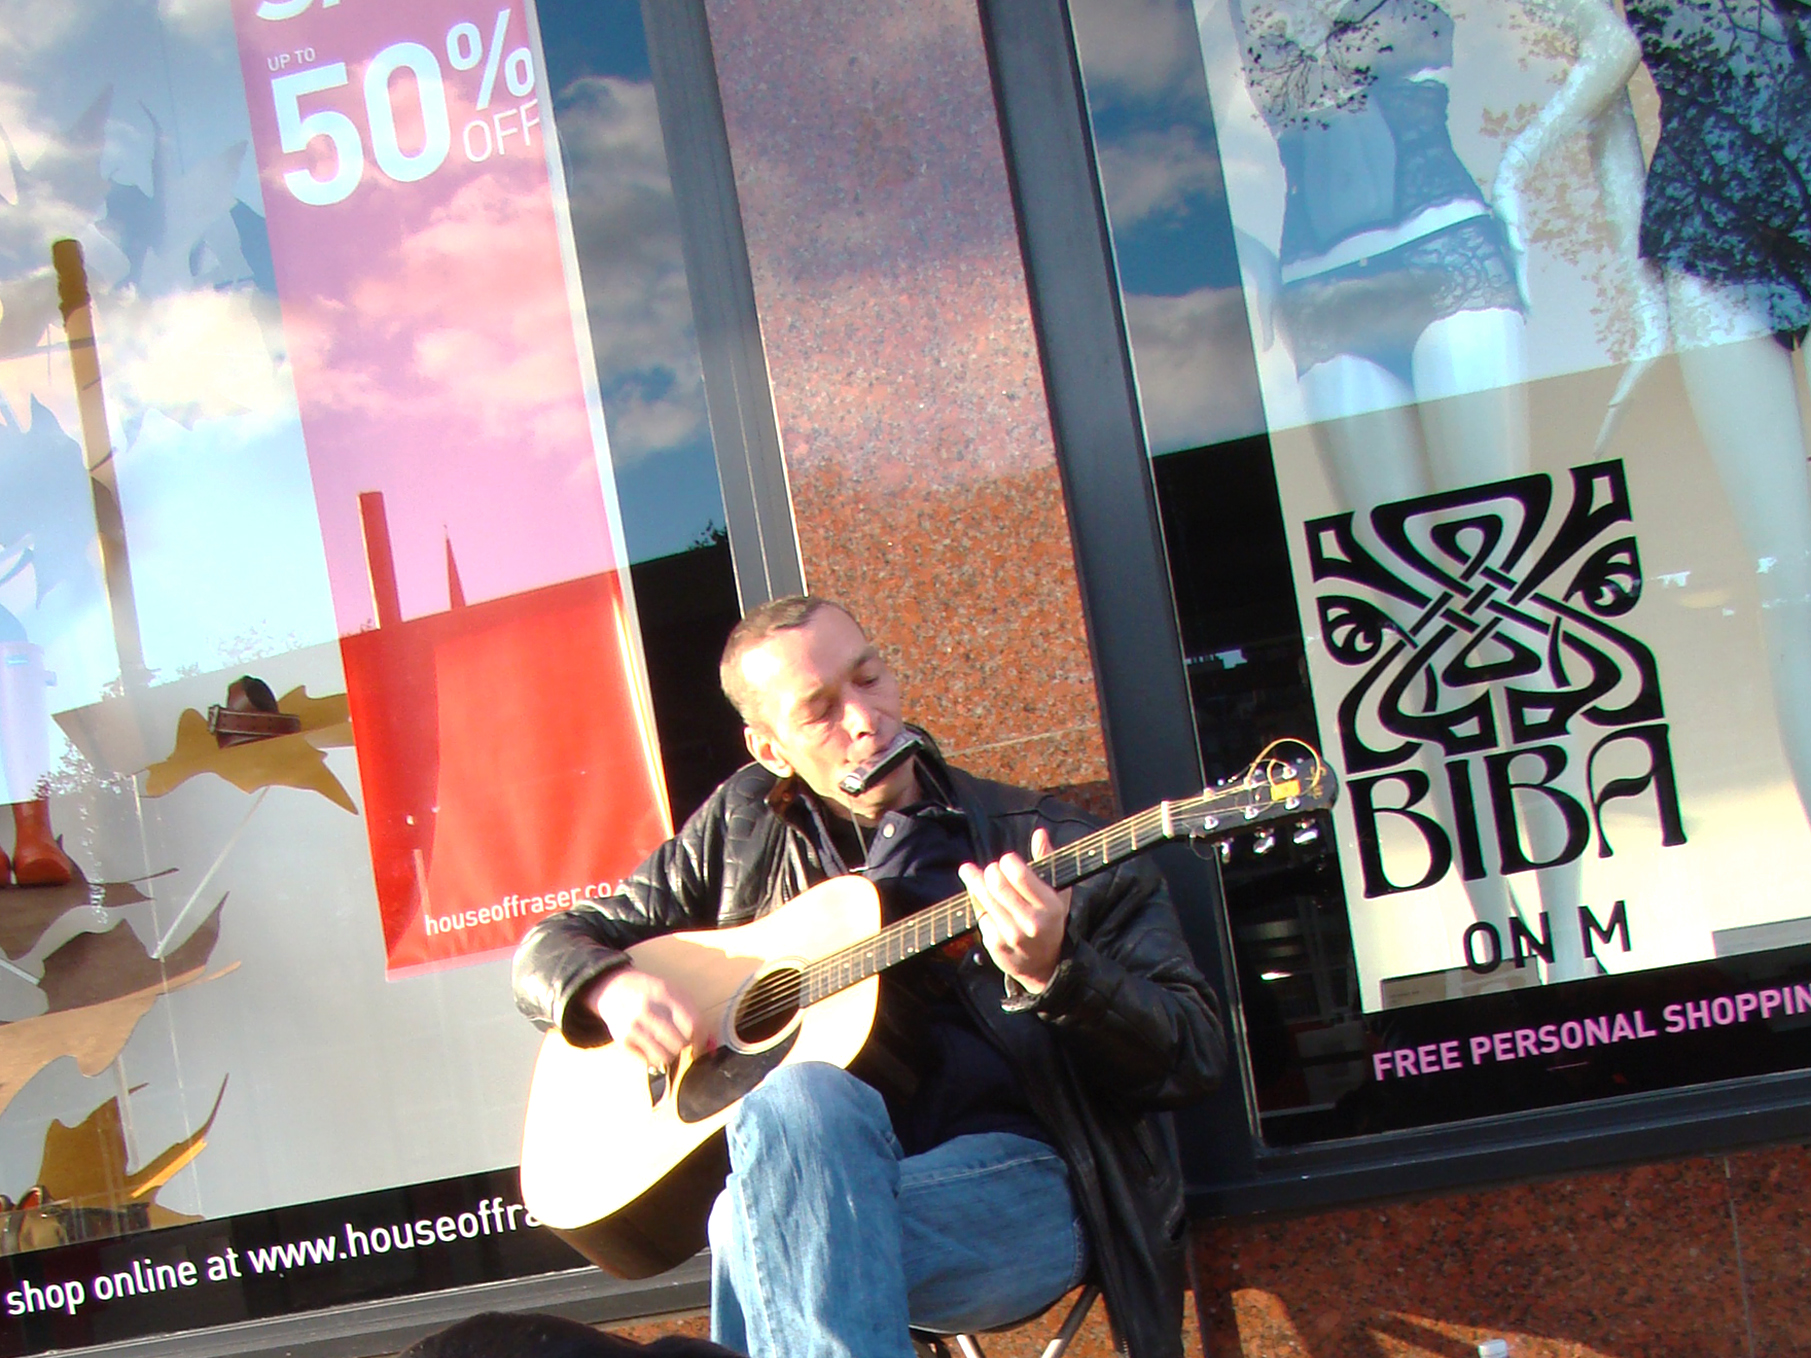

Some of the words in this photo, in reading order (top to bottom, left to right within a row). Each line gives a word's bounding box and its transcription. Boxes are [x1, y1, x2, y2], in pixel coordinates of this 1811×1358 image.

[266, 53, 291, 72] UP
[294, 47, 316, 65] TO
[271, 8, 536, 206] 50%
[463, 98, 540, 163] OFF
[1345, 723, 1688, 899] BIBA
[1462, 910, 1556, 975] ON
[1577, 899, 1632, 959] M
[1372, 1040, 1464, 1081] FREE
[1470, 1010, 1657, 1066] PERSONAL
[1663, 982, 1811, 1034] SHOPPIN
[6, 1280, 86, 1316] shop
[94, 1258, 198, 1301] online
[207, 1246, 242, 1283] at
